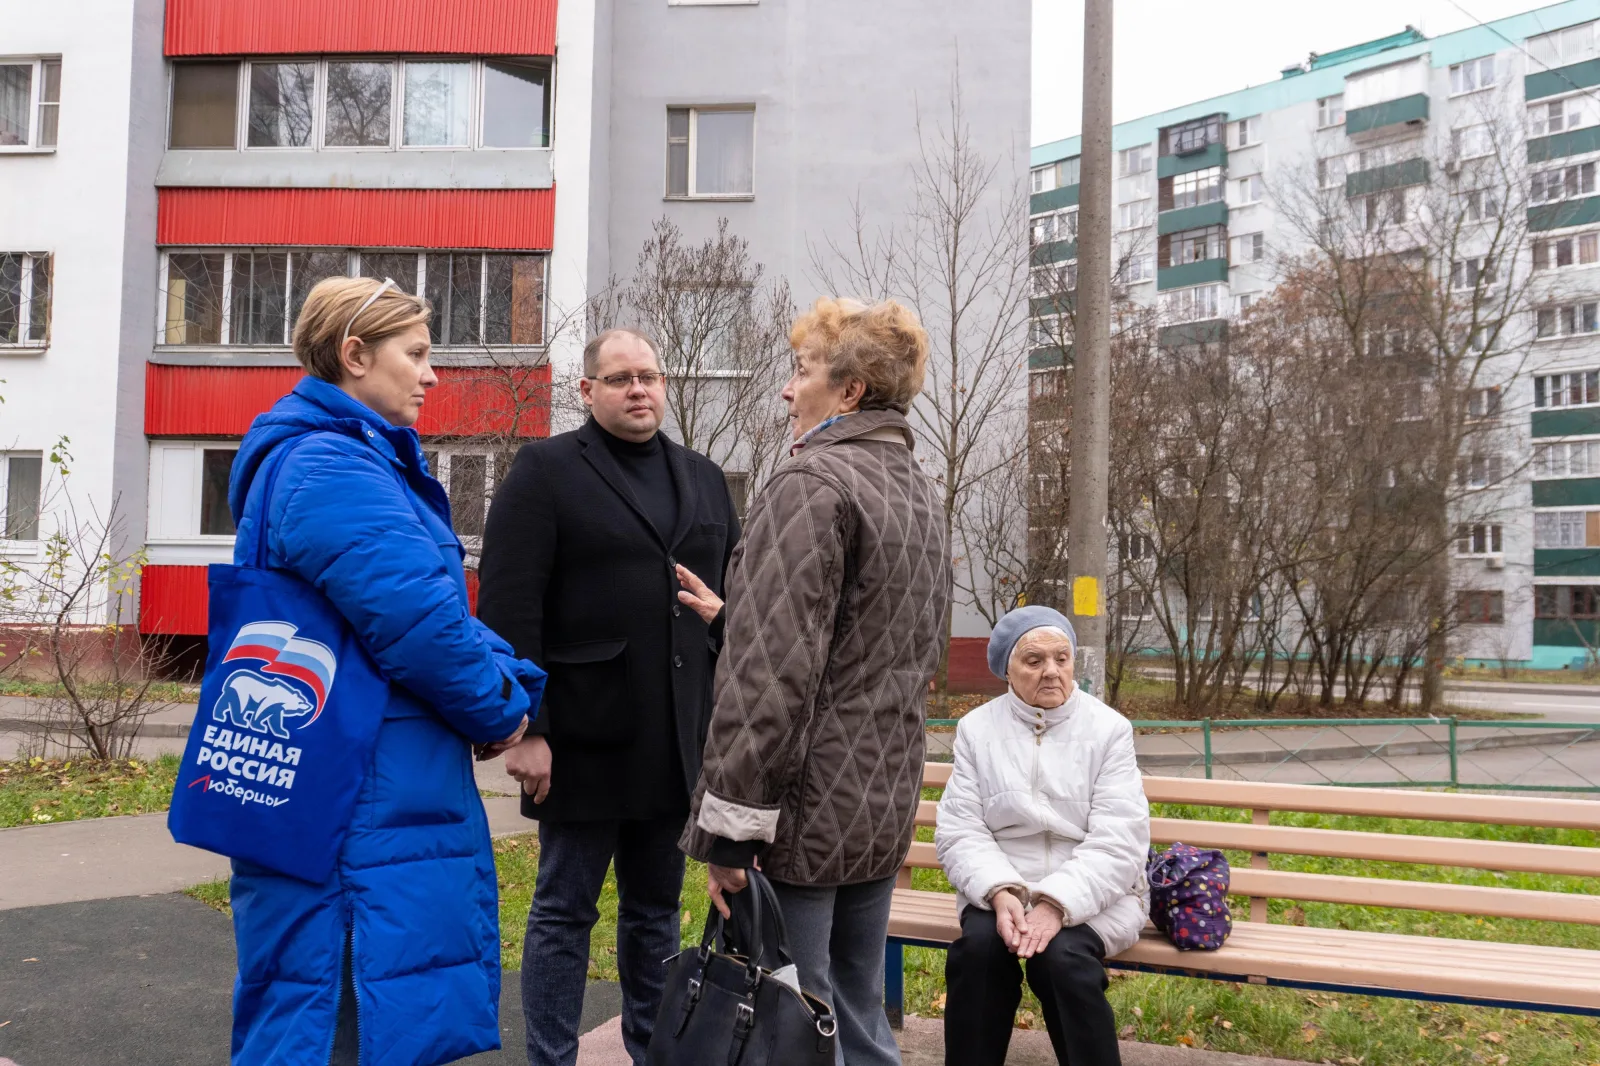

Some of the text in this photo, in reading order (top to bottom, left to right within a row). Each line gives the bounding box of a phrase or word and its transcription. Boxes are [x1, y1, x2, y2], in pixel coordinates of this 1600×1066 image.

[203, 725, 302, 767] ЕДИНАЯ
[196, 747, 296, 789] РОССИЯ
[188, 775, 290, 807] Люберцы
